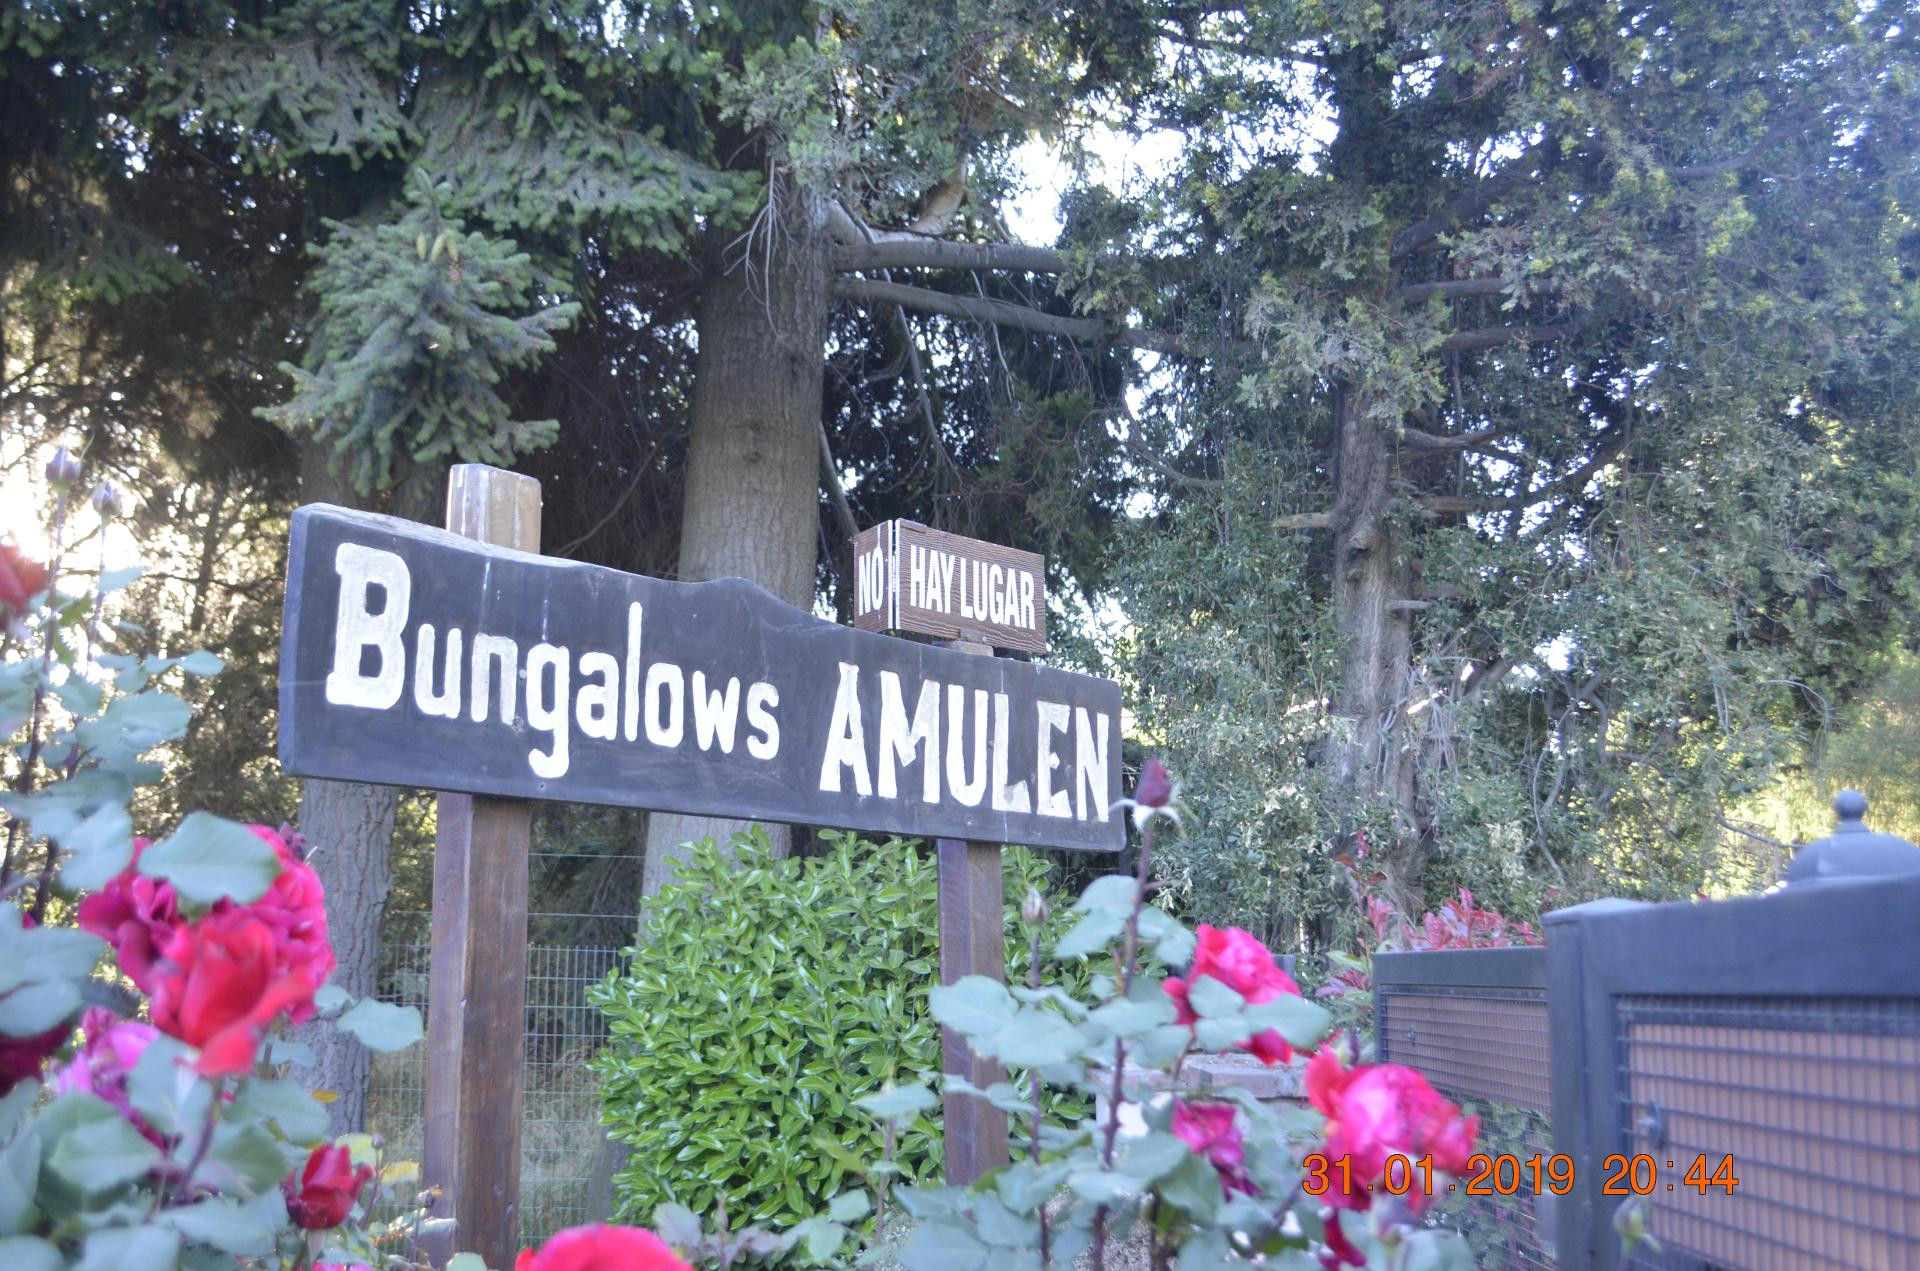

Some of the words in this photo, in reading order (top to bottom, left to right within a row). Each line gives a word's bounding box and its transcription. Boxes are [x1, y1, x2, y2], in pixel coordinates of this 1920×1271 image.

[858, 547, 884, 617] NO
[910, 544, 956, 614] HAY
[960, 557, 1036, 630] LUGAR
[325, 541, 780, 779] Bungalows
[819, 661, 1110, 823] AMULEN
